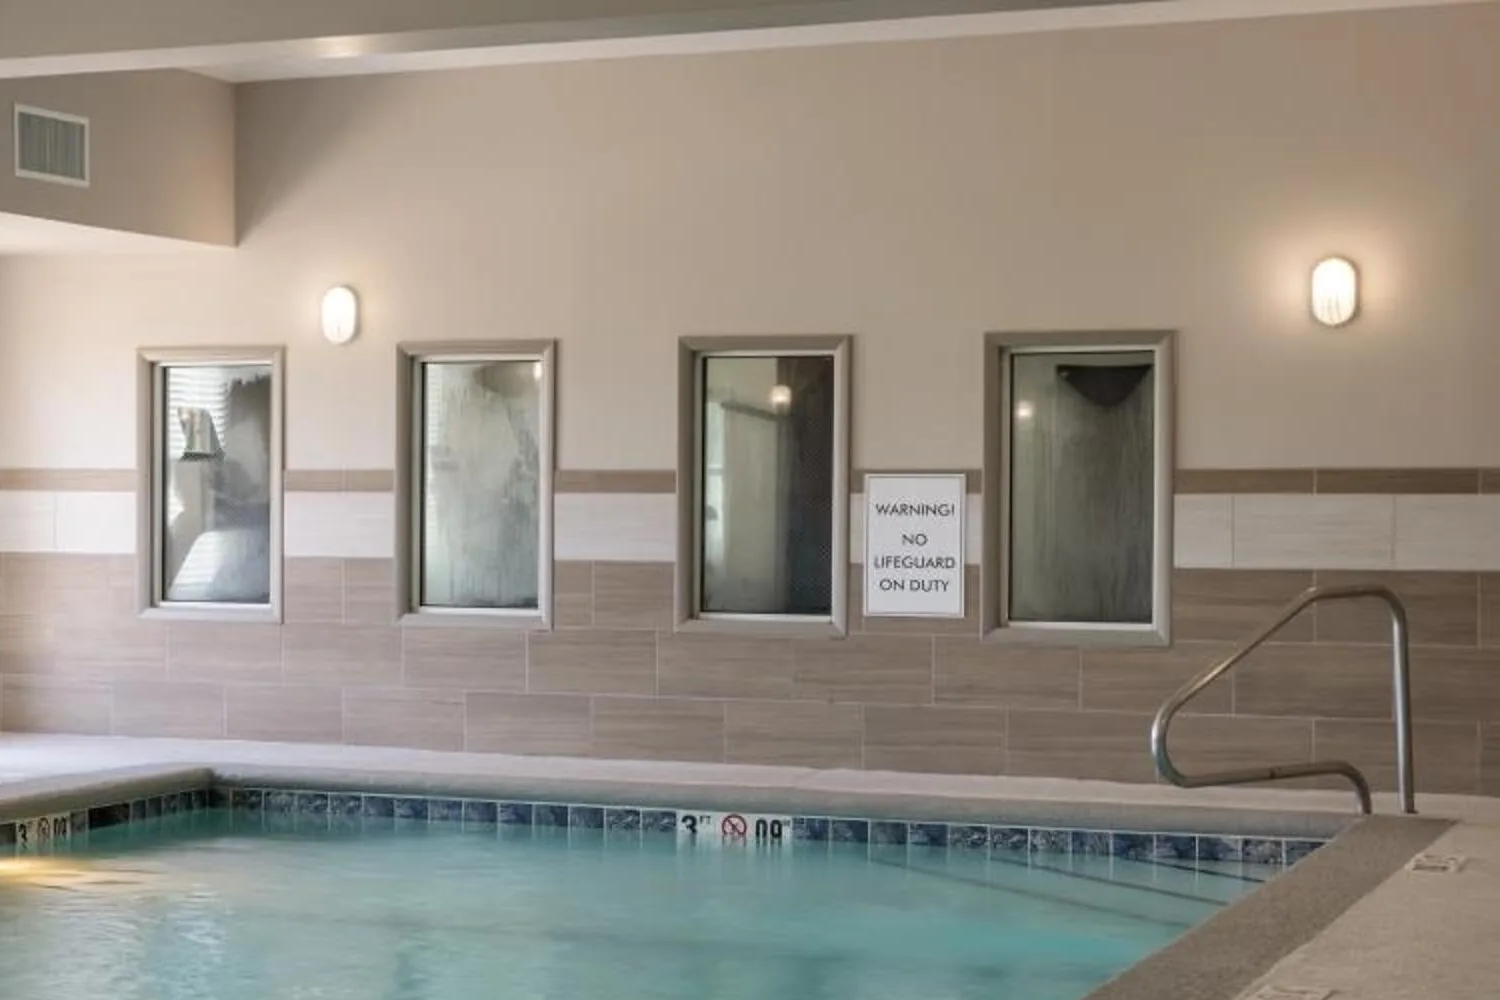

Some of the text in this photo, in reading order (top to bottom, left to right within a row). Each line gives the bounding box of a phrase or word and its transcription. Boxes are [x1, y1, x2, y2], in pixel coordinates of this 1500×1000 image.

[875, 503, 955, 517] WARNING!
[902, 533, 928, 546] NO
[873, 555, 956, 569] LIFEGUARD
[879, 579, 949, 592] ON DUTY
